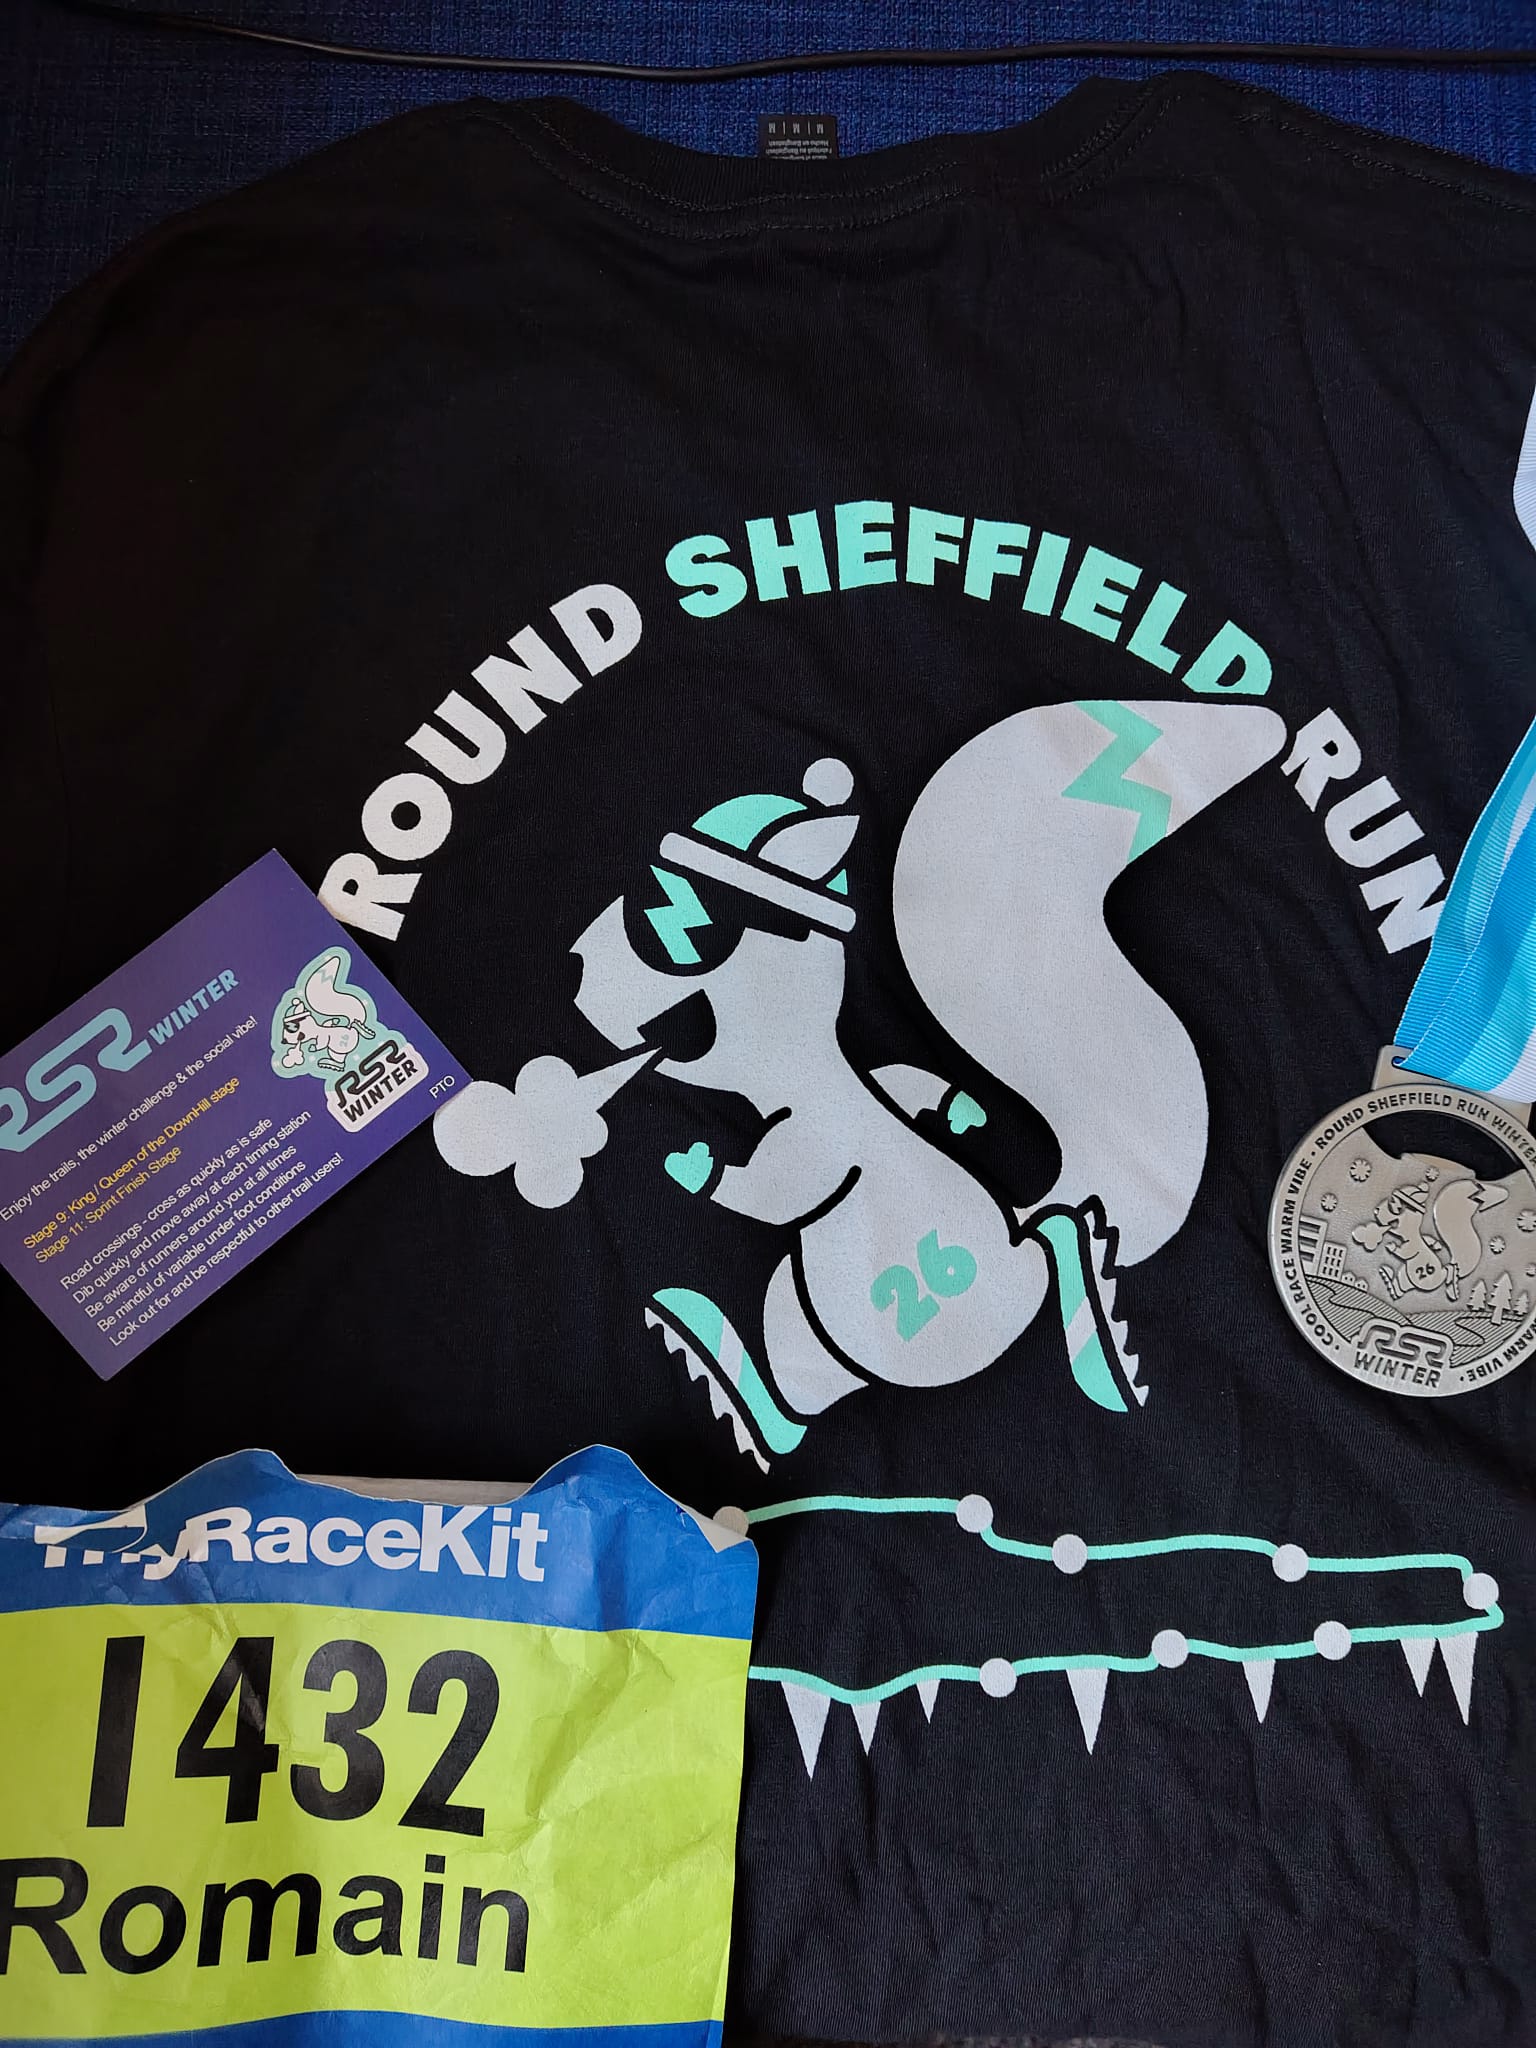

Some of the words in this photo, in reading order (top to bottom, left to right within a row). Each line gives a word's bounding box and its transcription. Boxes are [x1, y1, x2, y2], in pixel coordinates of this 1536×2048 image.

[317, 583, 643, 942] ROUND
[664, 500, 1273, 696] SHEFFIELD
[1280, 706, 1446, 954] RUN
[148, 969, 239, 1046] WINTER
[0, 1192, 33, 1221] Enjoy
[30, 1179, 52, 1197] the
[48, 1159, 81, 1182] trails,
[76, 1143, 98, 1161] the
[95, 1117, 129, 1146] winter
[128, 1081, 178, 1122] challenge
[175, 1072, 189, 1084] &
[184, 1059, 205, 1076] the
[203, 1034, 235, 1063] social
[231, 1015, 258, 1039] vibe!
[343, 1059, 418, 1123] WINTER
[429, 1075, 455, 1099] PTO
[1314, 1108, 1364, 1150] ROUND
[1367, 1092, 1452, 1114] SHEFFIELD
[23, 1221, 58, 1249] Stage
[55, 1211, 71, 1224] 9:
[67, 1191, 97, 1215] King
[98, 1158, 138, 1190] Queen
[136, 1145, 149, 1161] of
[146, 1135, 167, 1153] the
[163, 1097, 212, 1139] DownHill
[209, 1077, 240, 1104] stage
[35, 1235, 70, 1263] Stage
[69, 1220, 88, 1236] 11:
[84, 1194, 120, 1224] Sprint
[115, 1171, 151, 1200] Finish
[147, 1146, 182, 1174] Stage
[59, 1259, 94, 1290] Road
[92, 1223, 143, 1265] crossings
[147, 1194, 178, 1221] cross
[175, 1183, 192, 1199] as
[190, 1154, 226, 1186] quickly
[224, 1144, 241, 1159] as
[236, 1136, 251, 1148] is
[248, 1118, 273, 1140] safe
[72, 1285, 95, 1304] Dib
[94, 1255, 131, 1288] quickly
[129, 1236, 153, 1259] and
[150, 1214, 183, 1242] move
[180, 1190, 210, 1218] away
[208, 1180, 223, 1195] at
[220, 1161, 249, 1185] each
[244, 1136, 280, 1165] timing
[276, 1111, 312, 1141] station
[1288, 1158, 1313, 1195] VIBE
[84, 1301, 105, 1318] Be
[103, 1274, 138, 1305] aware
[136, 1261, 149, 1277] of
[147, 1232, 189, 1269] runners
[187, 1200, 226, 1236] around
[222, 1186, 246, 1209] you
[243, 1176, 258, 1191] at
[254, 1165, 270, 1182] all
[266, 1145, 297, 1171] times
[96, 1315, 117, 1333] Be
[115, 1281, 155, 1319] mindful
[153, 1271, 166, 1288] of
[163, 1242, 206, 1277] variable
[204, 1216, 236, 1246] under
[232, 1199, 258, 1221] foot
[255, 1161, 306, 1205] conditions
[109, 1320, 141, 1347] Look
[138, 1304, 159, 1324] out
[154, 1292, 172, 1310] for
[170, 1274, 194, 1298] and
[189, 1264, 208, 1281] be
[206, 1222, 257, 1268] respectful
[253, 1216, 268, 1228] to
[266, 1193, 294, 1219] other
[290, 1176, 314, 1198] trail
[310, 1151, 344, 1183] users!
[1280, 1199, 1297, 1255] WARM
[1283, 1258, 1306, 1304] RACE
[1415, 1263, 1436, 1280] 26
[869, 1228, 978, 1342] 26
[1300, 1303, 1334, 1346] COOL
[1353, 1351, 1441, 1388] WINTER
[1466, 1357, 1504, 1382] VIBE
[86, 1634, 501, 1838] 1432
[0, 1855, 530, 1975] Romain
